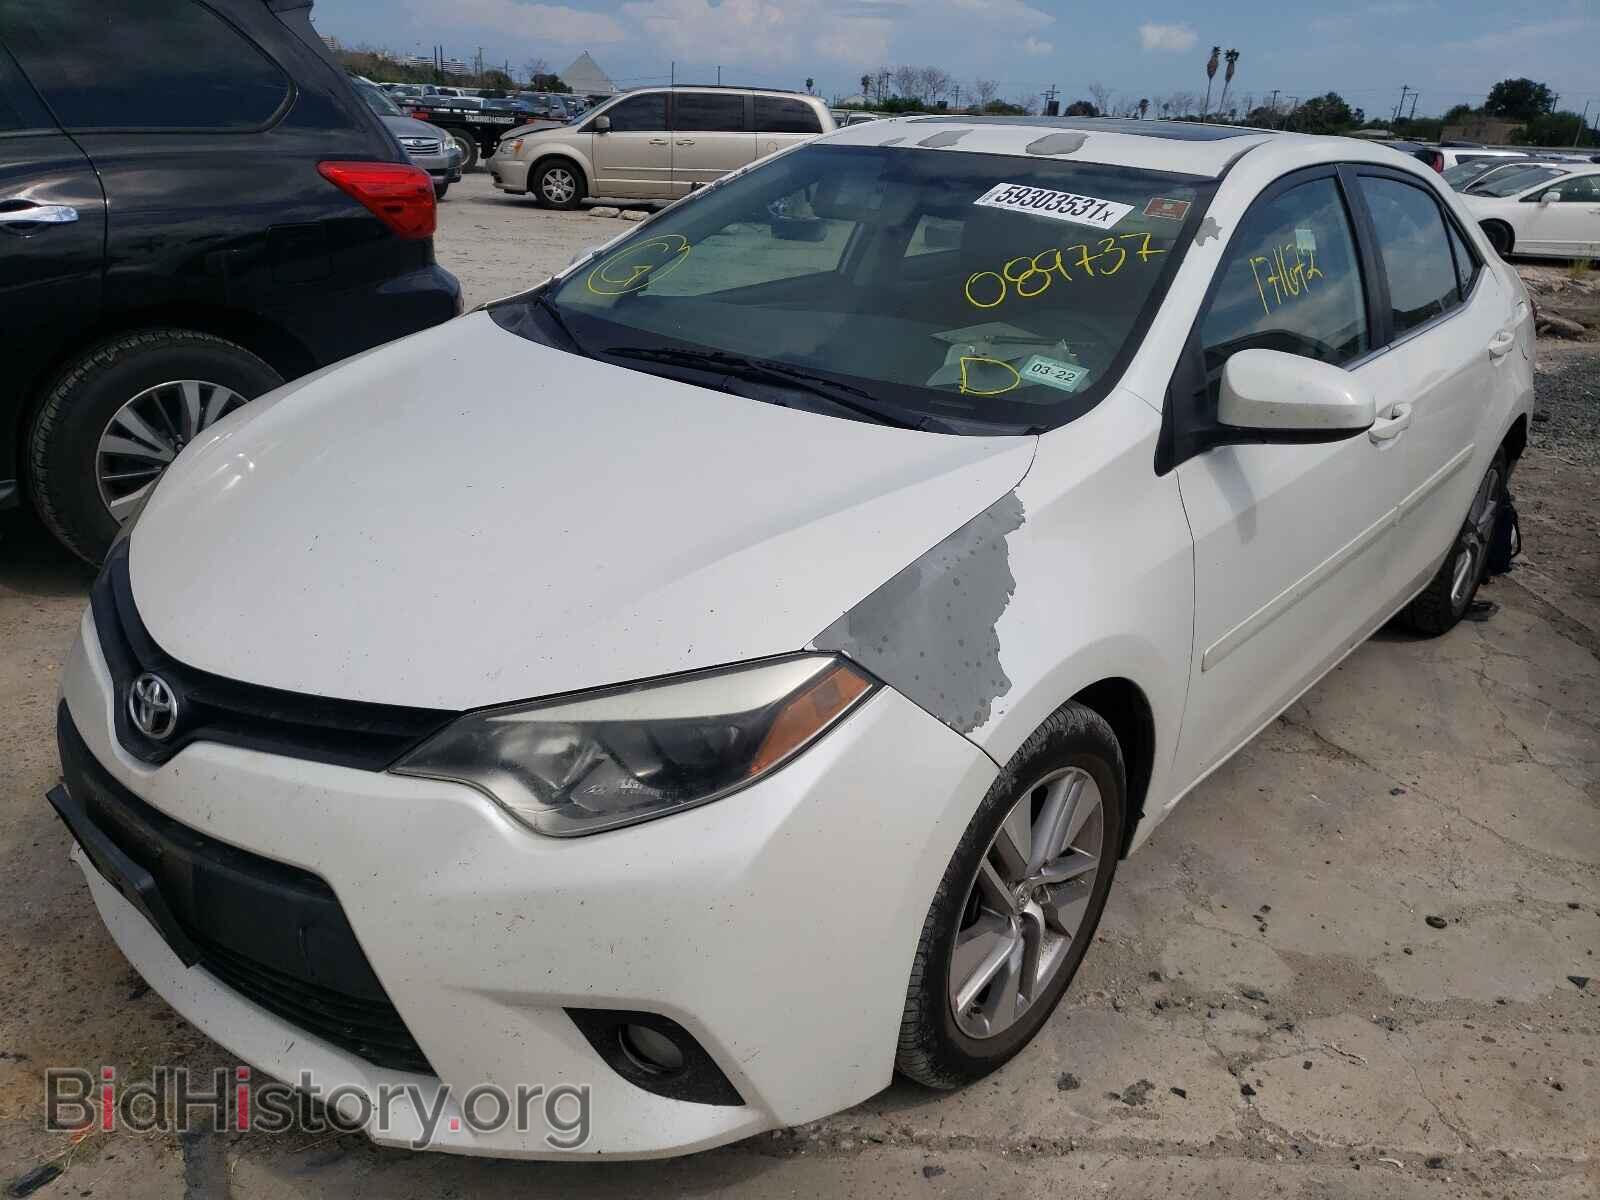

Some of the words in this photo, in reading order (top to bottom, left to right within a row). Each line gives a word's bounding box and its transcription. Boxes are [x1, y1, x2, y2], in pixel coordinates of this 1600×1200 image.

[965, 232, 1168, 308] 089737
[960, 356, 1021, 394] D
[1031, 363, 1076, 382] 03-22
